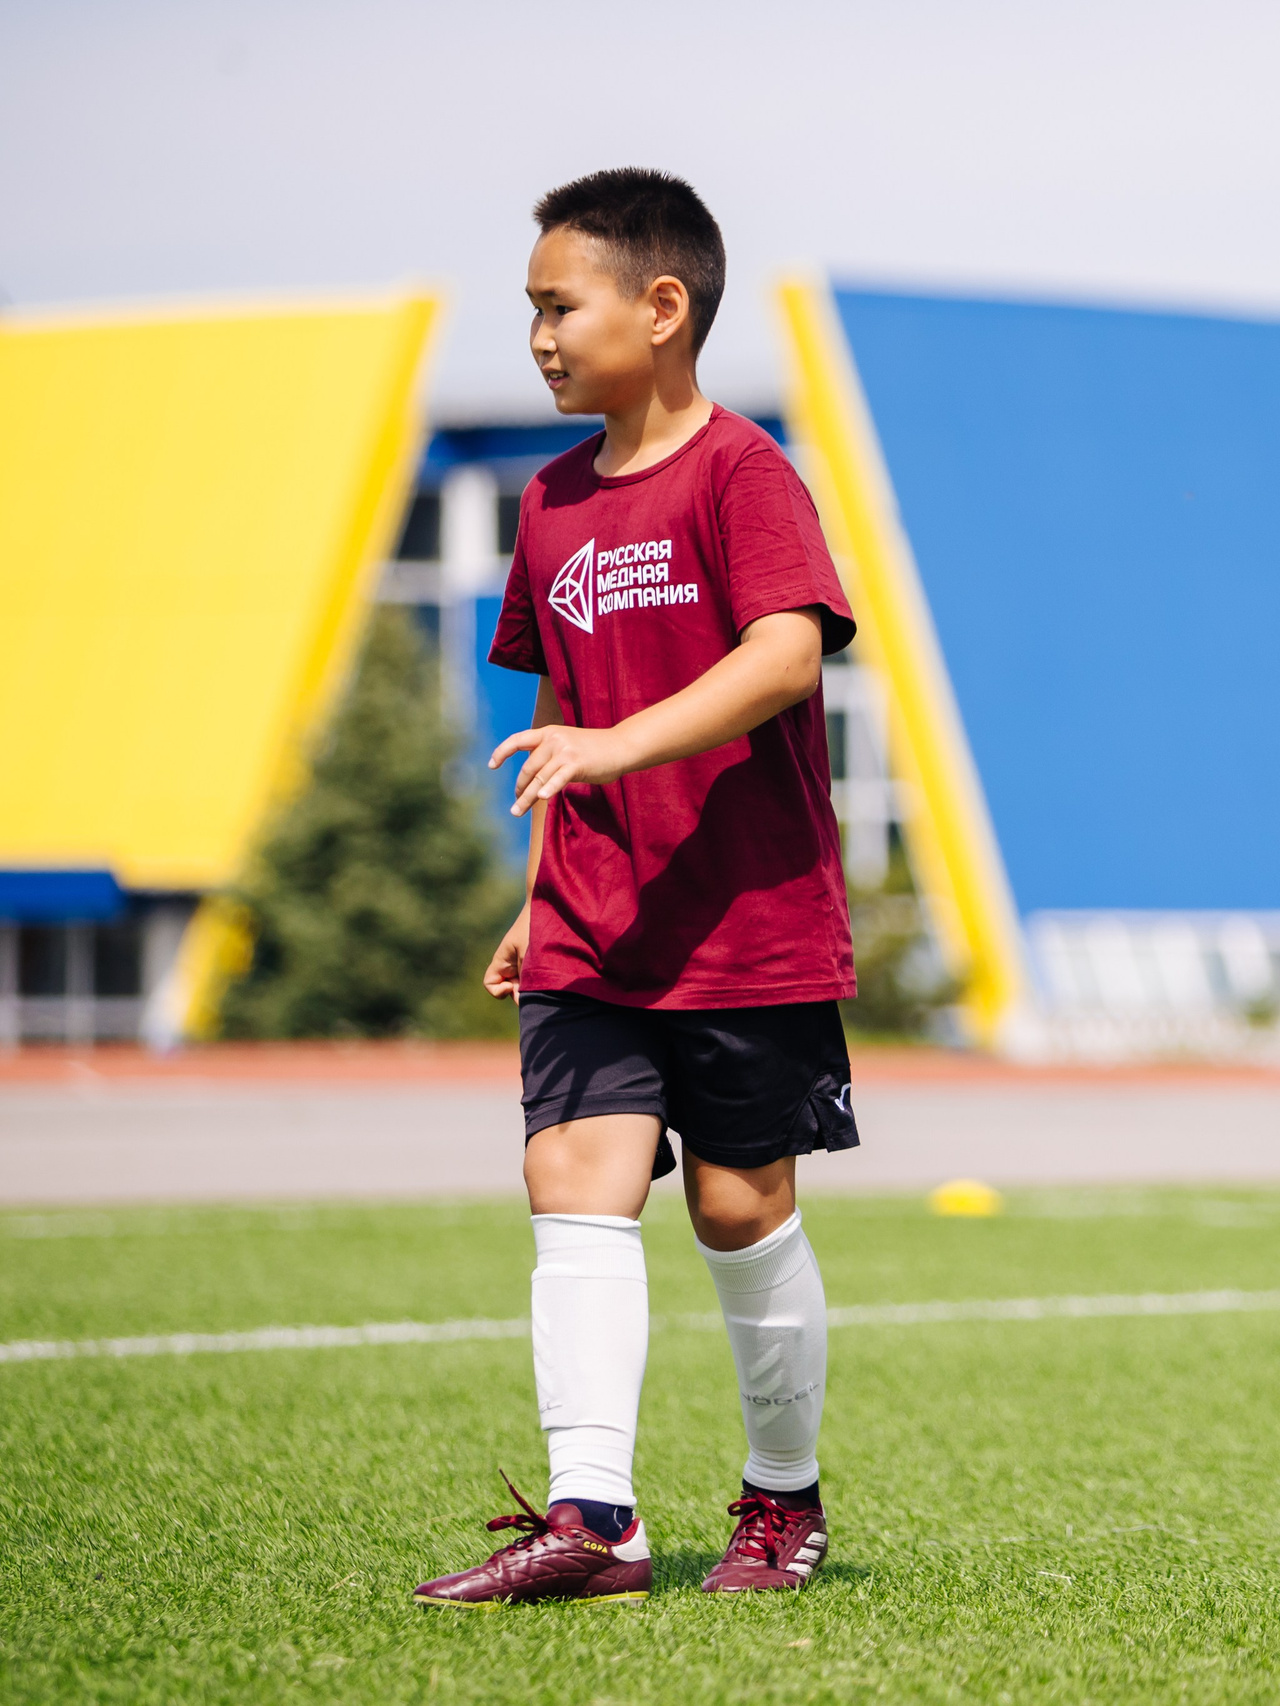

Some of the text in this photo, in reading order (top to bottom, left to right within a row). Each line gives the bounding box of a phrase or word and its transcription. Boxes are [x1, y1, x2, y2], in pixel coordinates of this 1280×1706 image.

[597, 540, 672, 571] РУССКАЯ
[597, 562, 669, 593] МЕДНАЯ
[597, 584, 699, 615] КОМПАНИЯ
[583, 1540, 608, 1554] COPA
